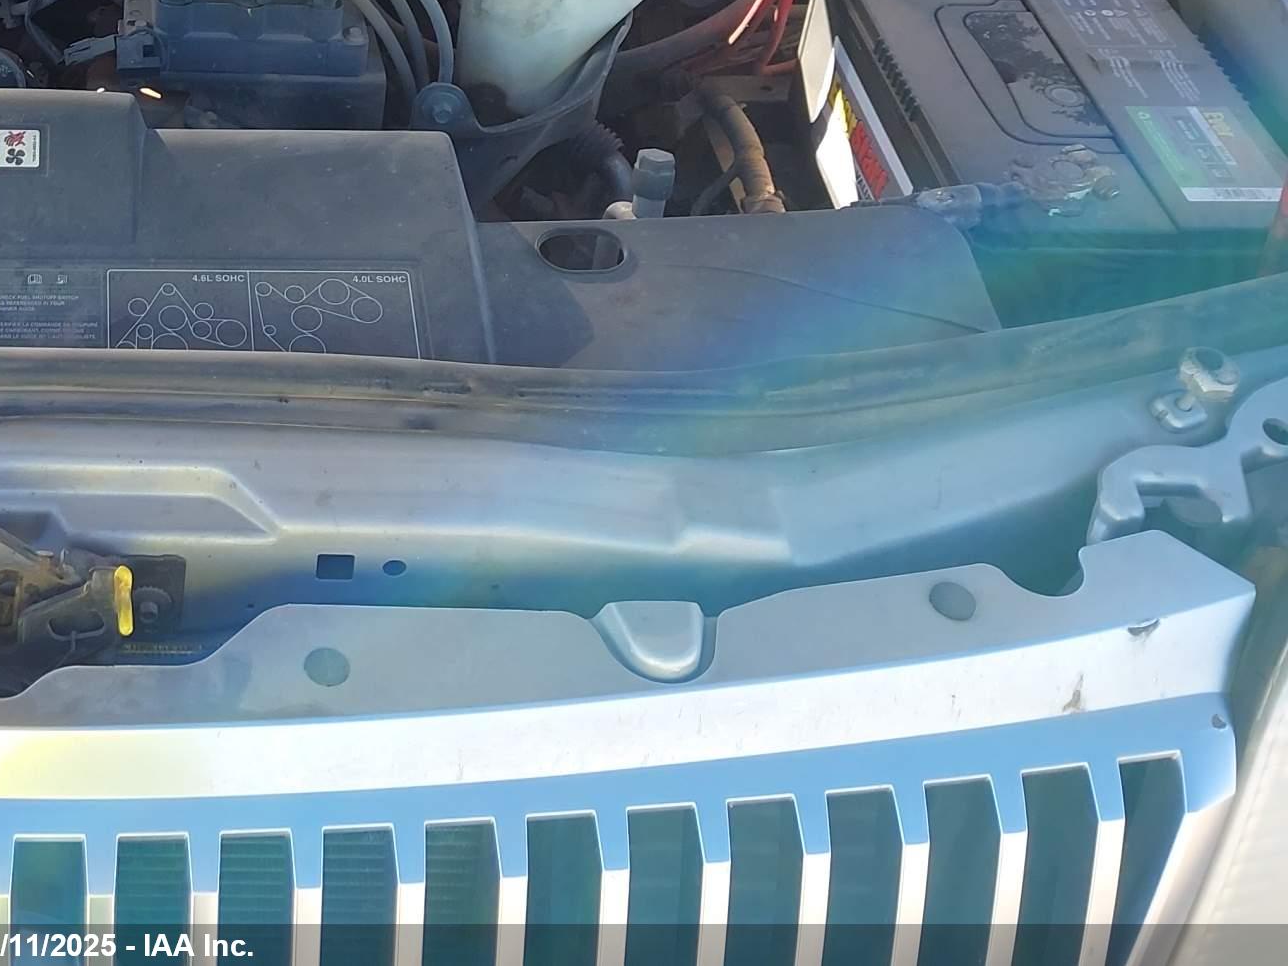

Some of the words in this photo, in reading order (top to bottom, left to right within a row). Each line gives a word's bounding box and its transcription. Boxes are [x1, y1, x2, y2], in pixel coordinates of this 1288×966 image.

[215, 274, 245, 282] SOHC
[352, 275, 373, 283] 4.0L
[375, 275, 407, 283] SOHC
